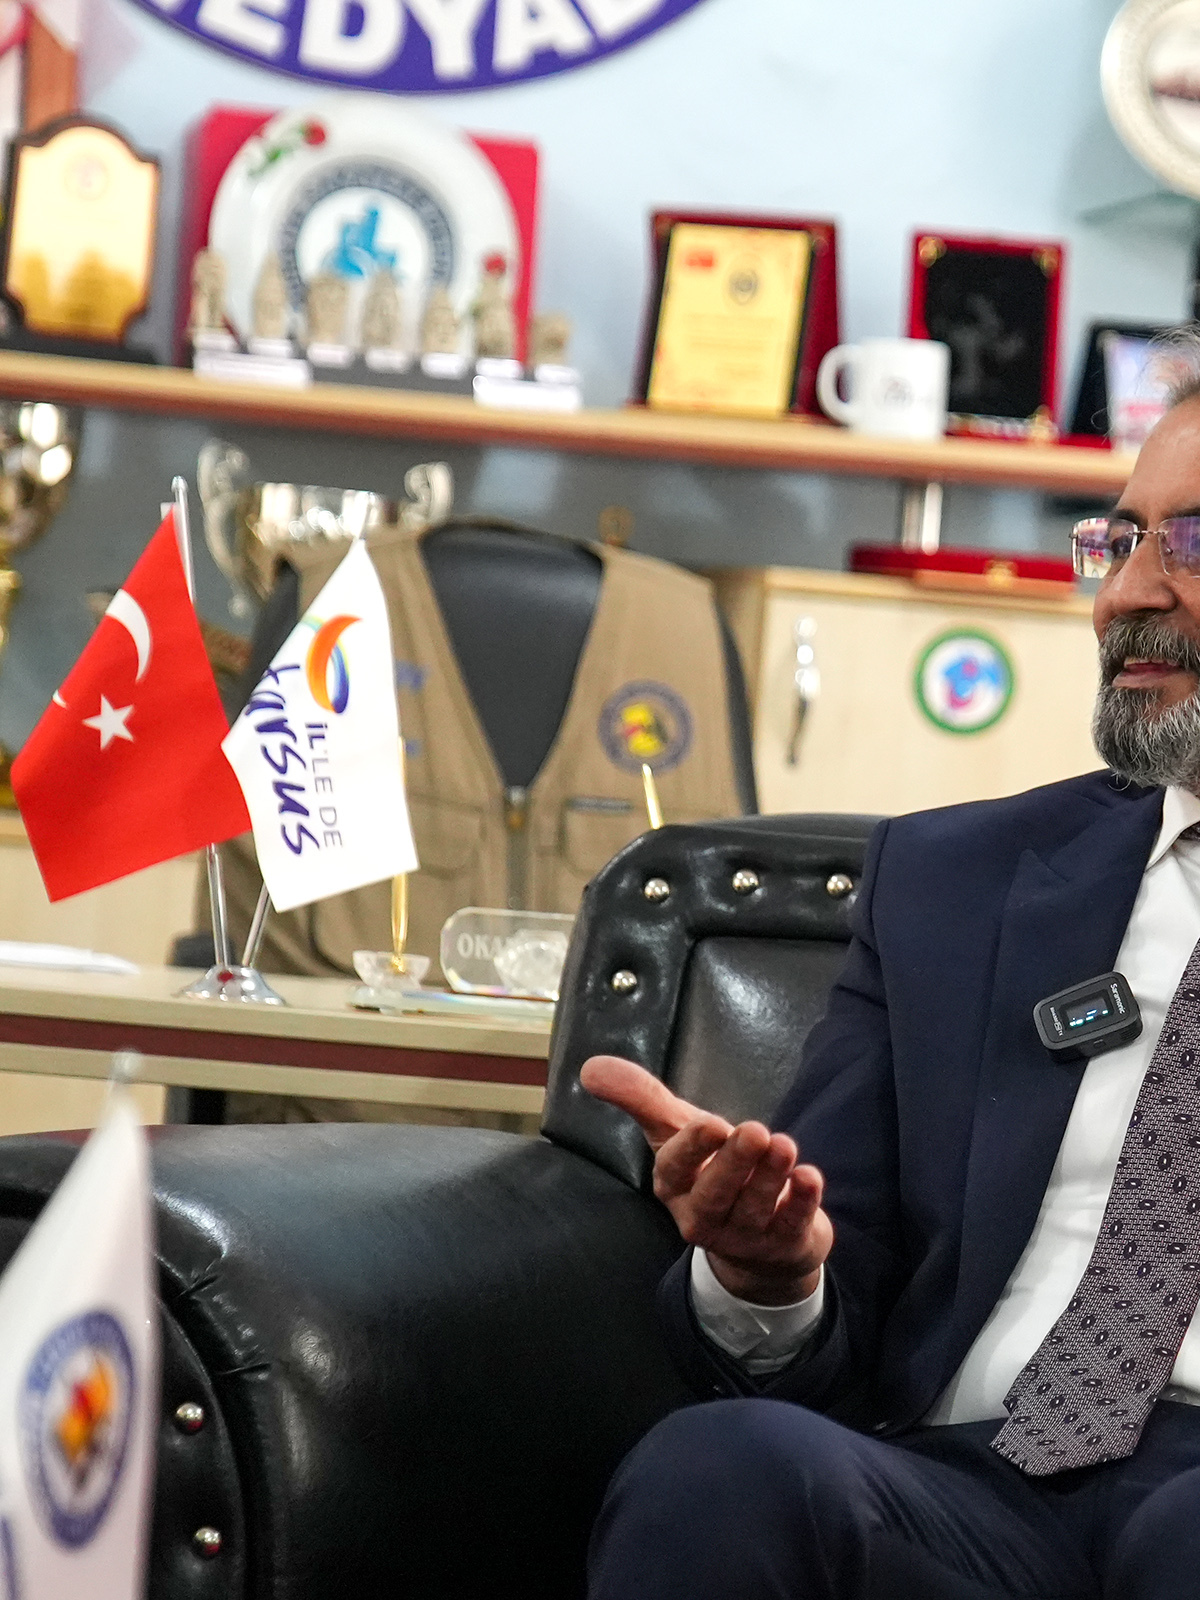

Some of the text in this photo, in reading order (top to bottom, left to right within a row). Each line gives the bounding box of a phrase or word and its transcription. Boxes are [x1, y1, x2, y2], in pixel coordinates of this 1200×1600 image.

[152, 0, 667, 80] EDYA
[318, 806, 343, 848] DE
[457, 932, 515, 961] OKA
[1110, 983, 1125, 1014] Saramonic
